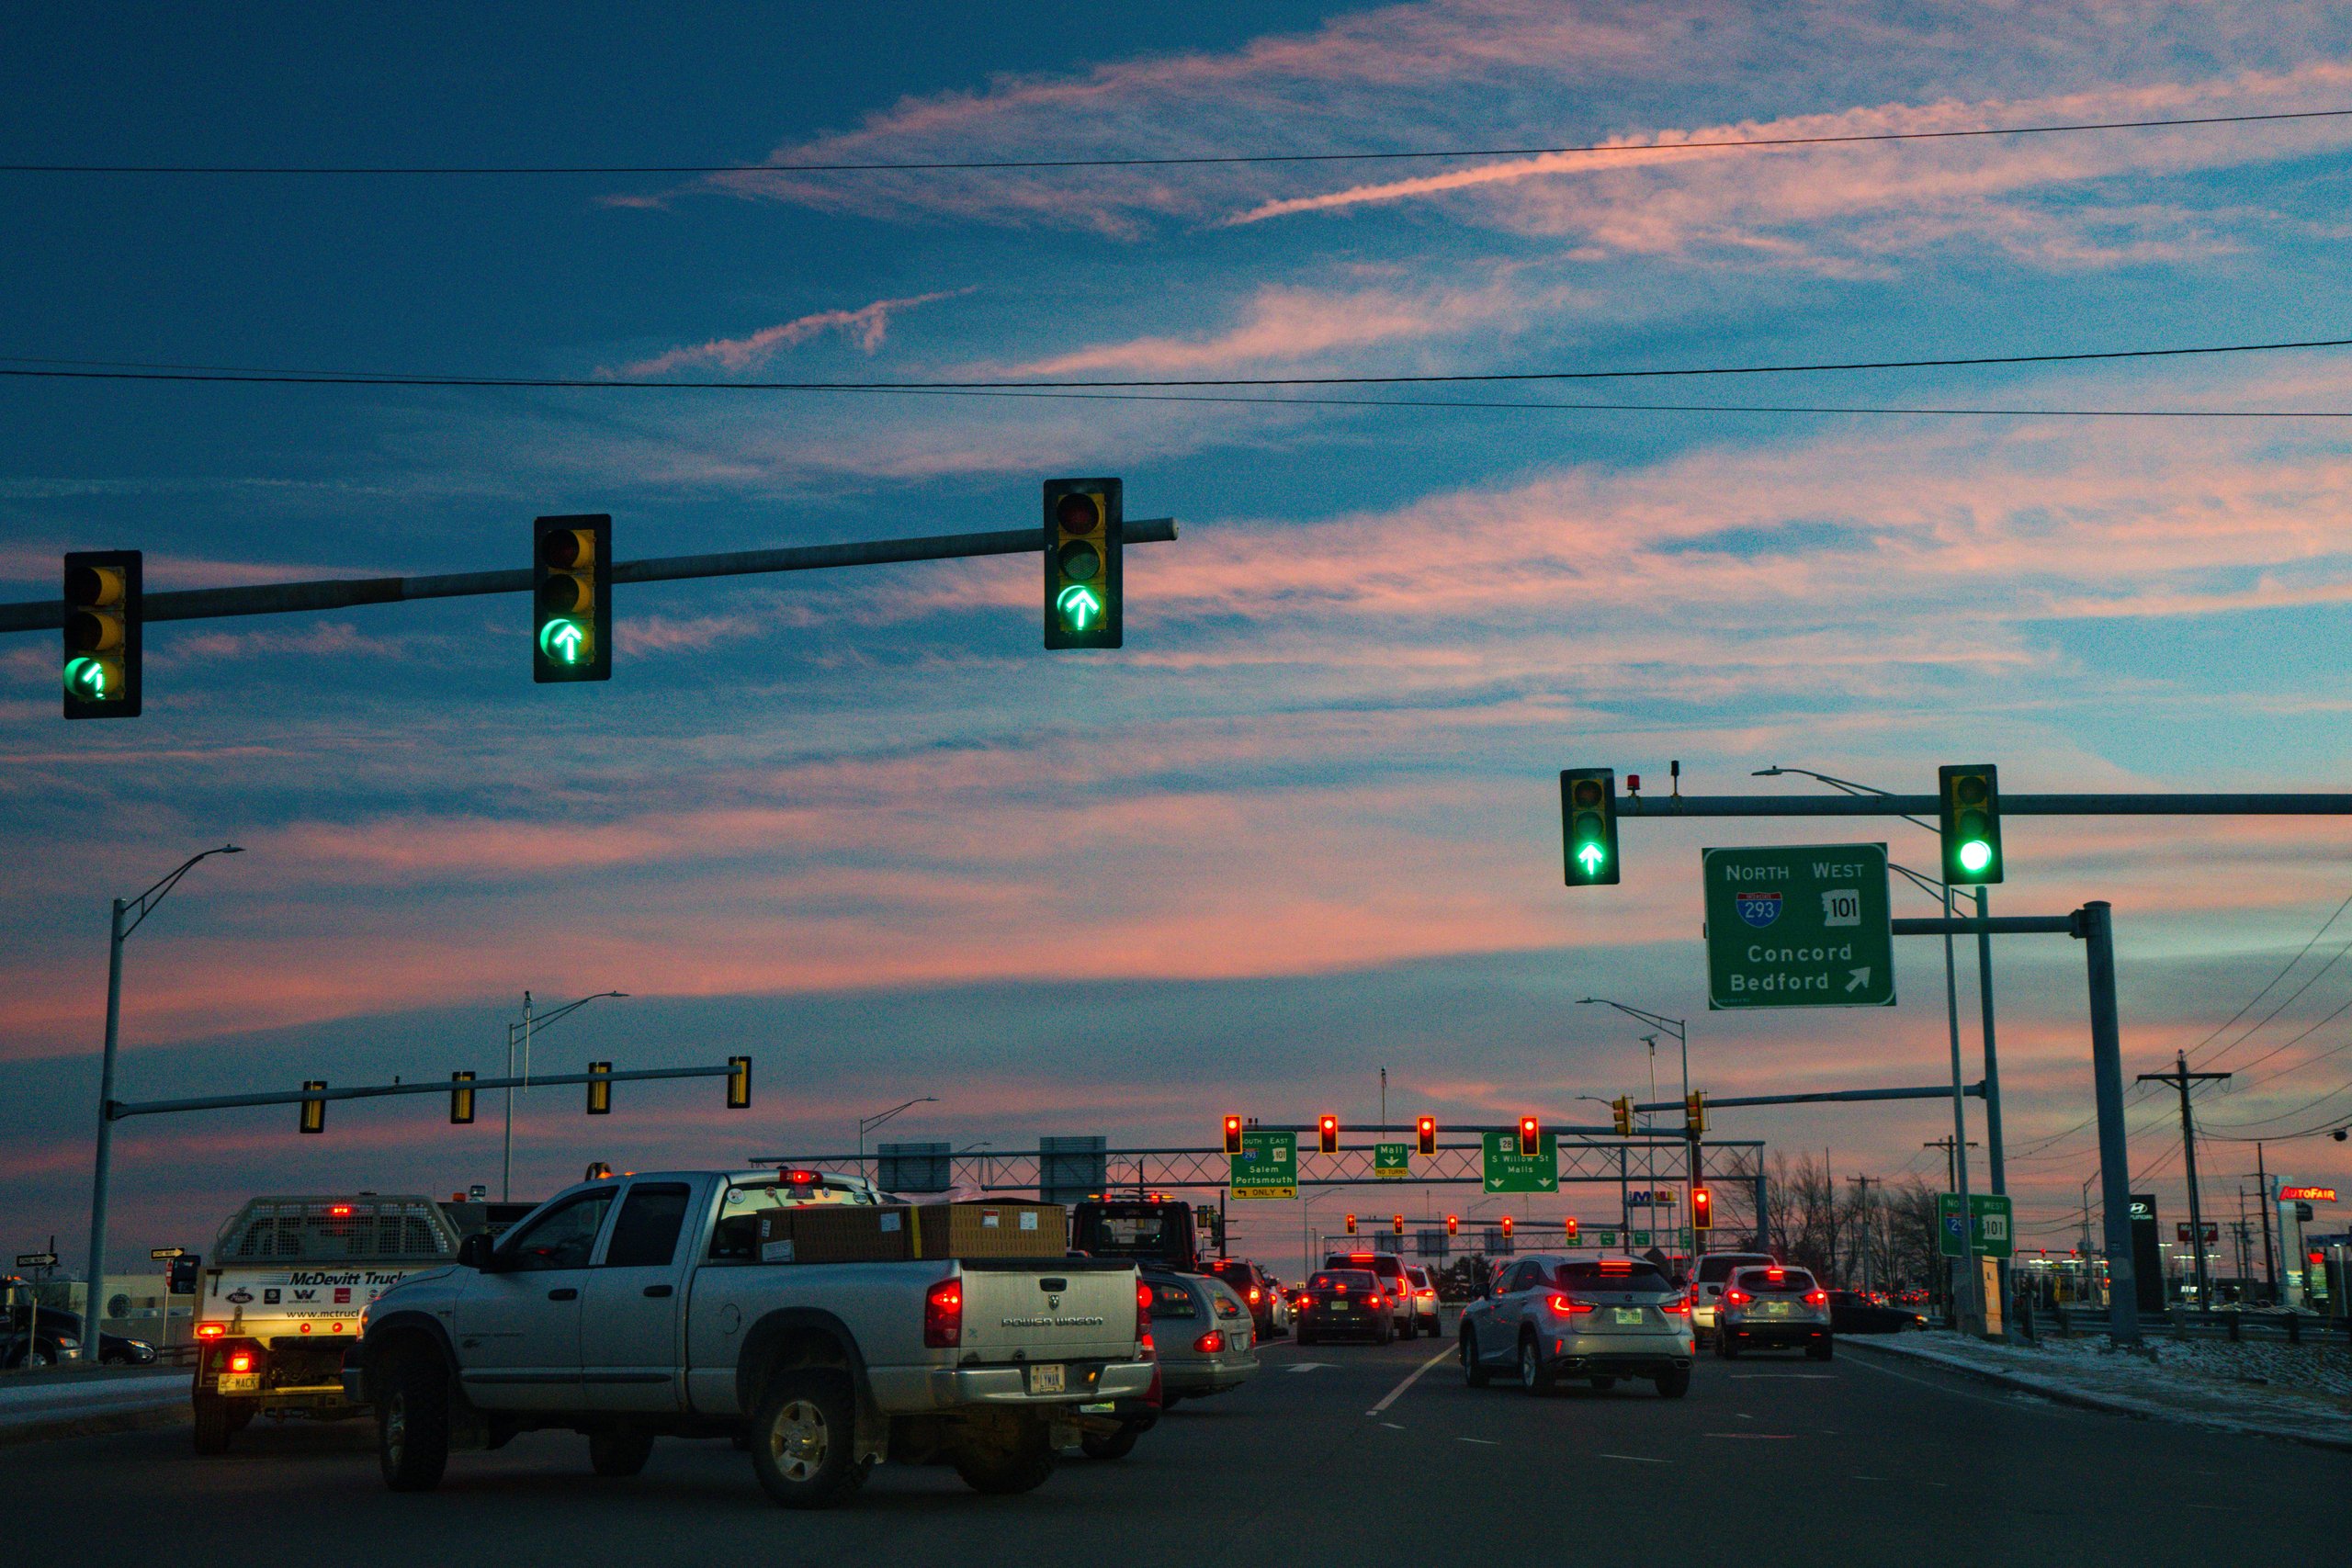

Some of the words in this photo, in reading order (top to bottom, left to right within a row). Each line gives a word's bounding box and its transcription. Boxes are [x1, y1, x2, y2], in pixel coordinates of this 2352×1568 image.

[1726, 864, 1789, 881] NORTH
[1813, 862, 1864, 878] WEST
[1745, 901, 1774, 919] 293
[1831, 897, 1857, 918] 101
[1747, 943, 1852, 963] Concord
[1730, 973, 1829, 992] Bedford
[1502, 1140, 1511, 1148] 28
[1275, 1150, 1286, 1159] 101
[1380, 1145, 1403, 1154] Mall
[1245, 1152, 1257, 1160] 293
[1491, 1155, 1498, 1163] S
[1250, 1165, 1279, 1173] Salem
[1236, 1176, 1293, 1184] Portsmouth
[1252, 1188, 1276, 1196] ONLY
[1984, 1201, 2005, 1211] WEST
[1985, 1221, 2002, 1235] 101
[289, 1272, 361, 1285] McDevitt
[1001, 1318, 1052, 1327] POWER
[1056, 1316, 1102, 1326] WAGON
